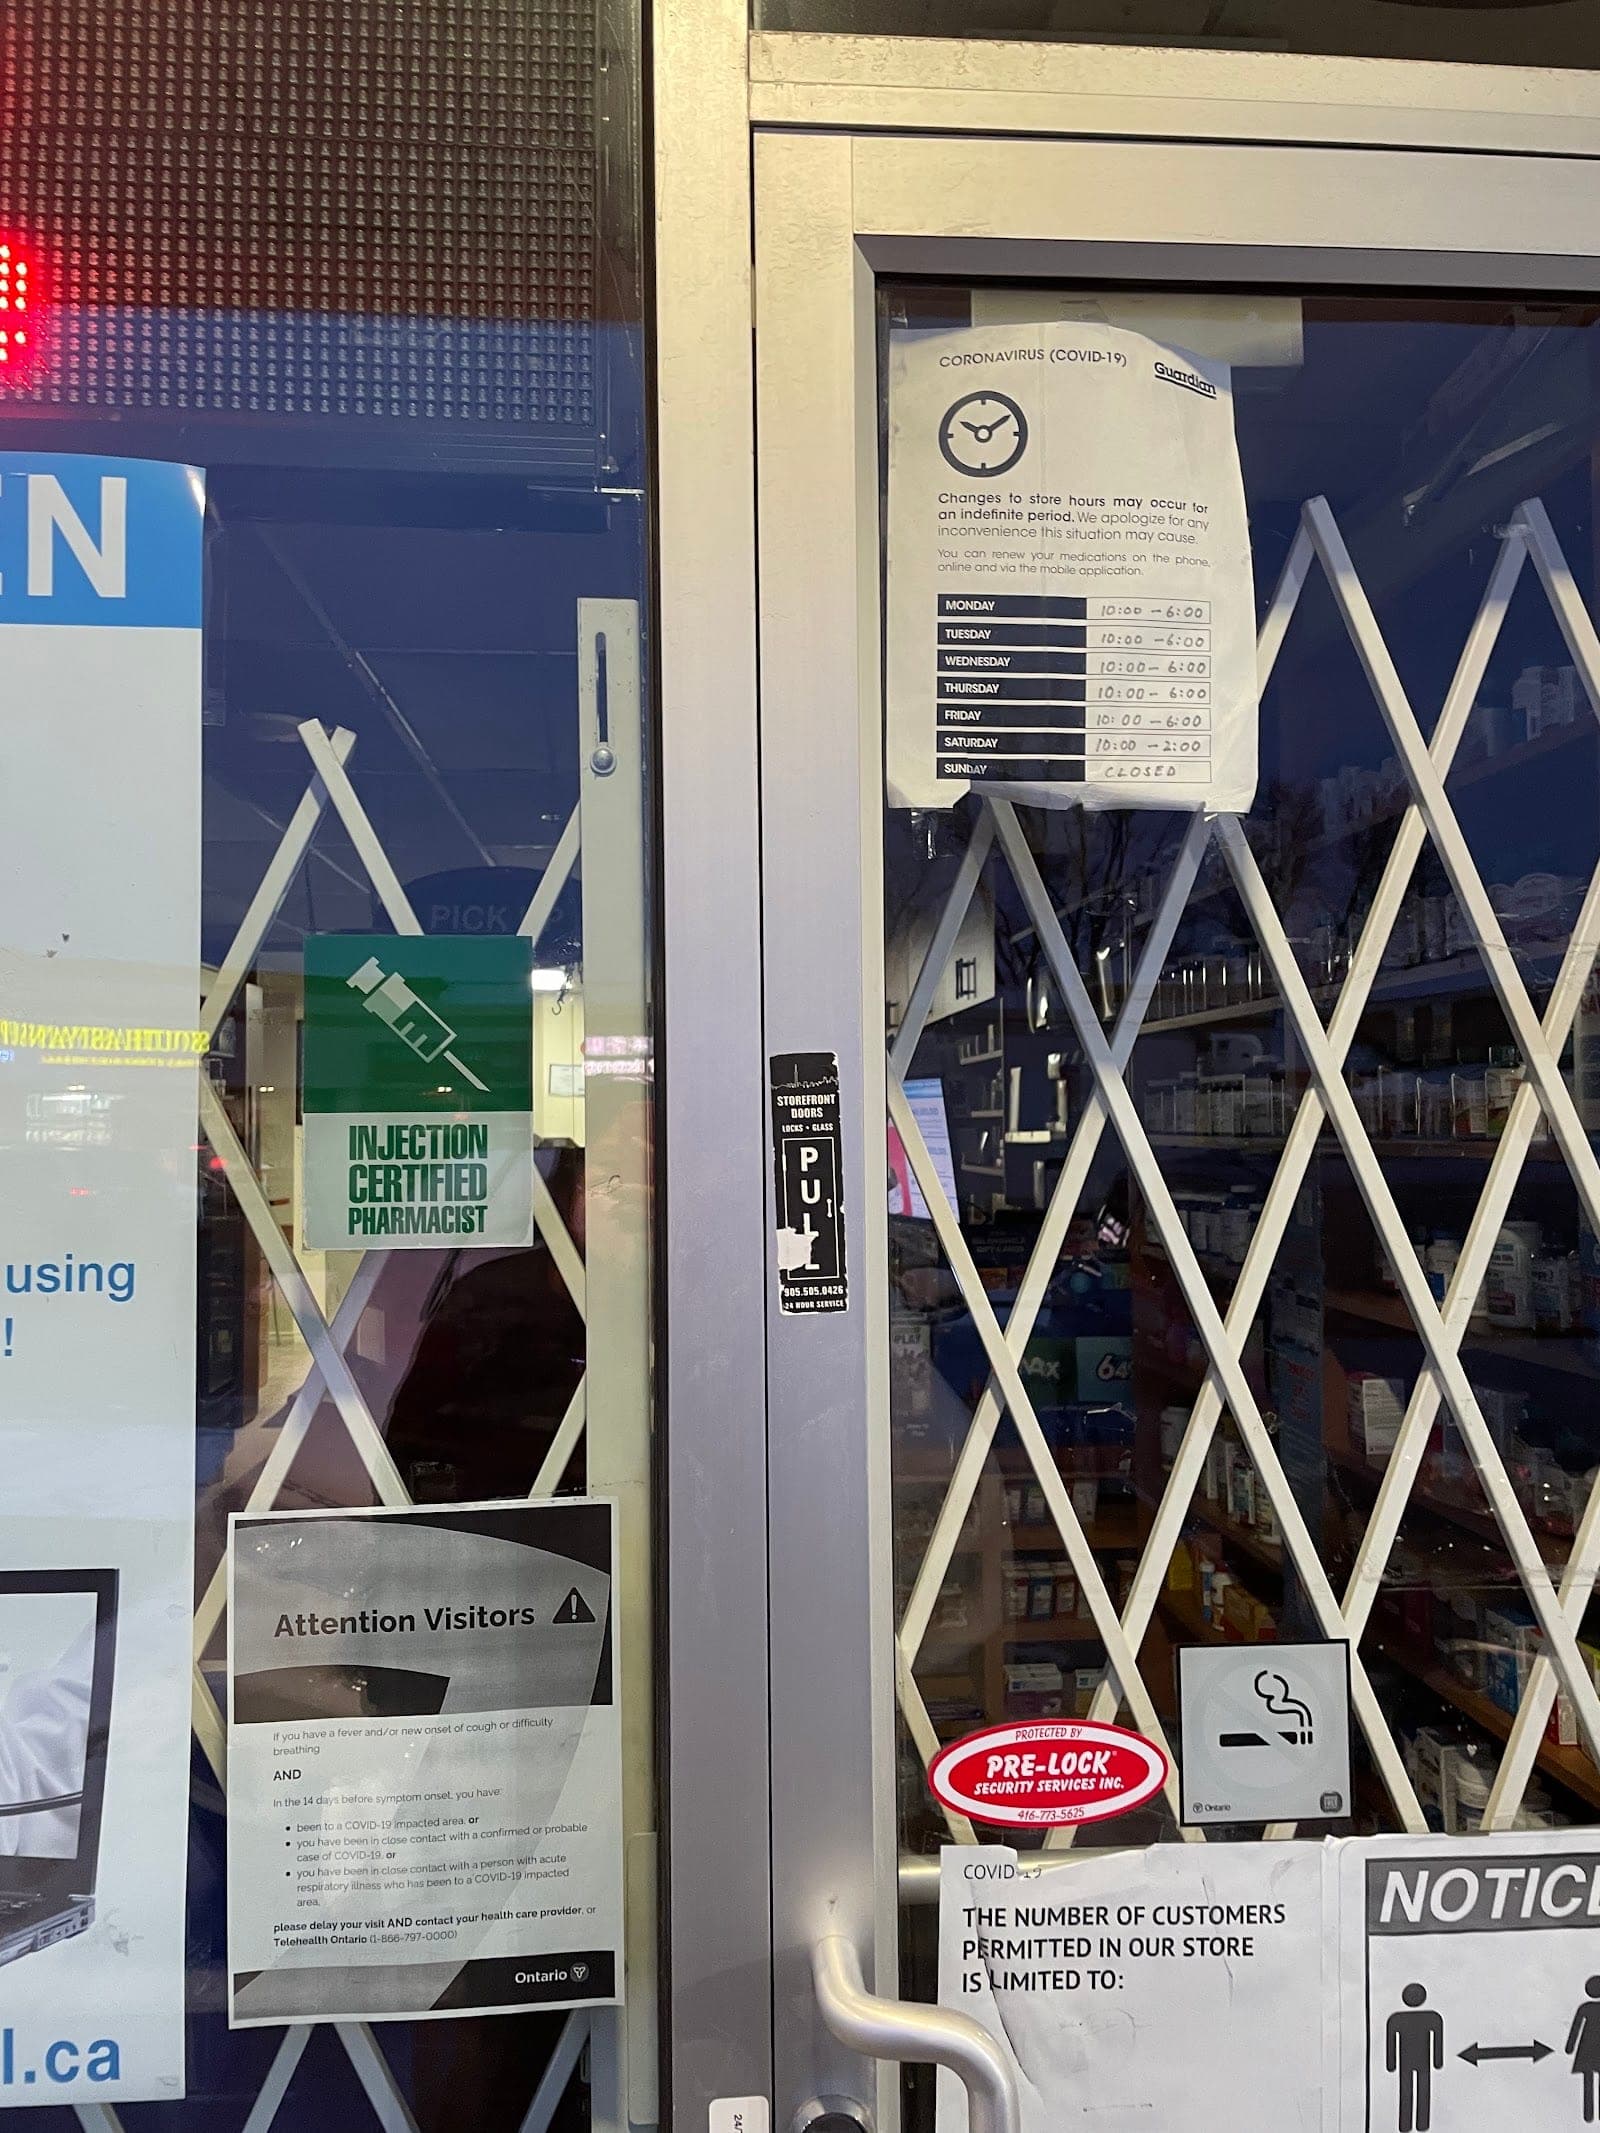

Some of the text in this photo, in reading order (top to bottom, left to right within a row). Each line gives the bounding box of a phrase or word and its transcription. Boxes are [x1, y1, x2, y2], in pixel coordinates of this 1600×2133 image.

[939, 349, 1127, 368] CORONAVIRUS (COVID-19)
[1154, 361, 1217, 395] Guardian
[938, 492, 1208, 513] Changes to store hours may occur for
[939, 508, 1209, 532] an indefinite period. We apologize for any
[0, 474, 127, 598] N
[938, 525, 1198, 544] inconvenience this situation may cause.
[938, 549, 958, 558] You
[964, 550, 986, 558] can
[992, 551, 1025, 559] renew
[1031, 551, 1054, 561] your
[1060, 553, 1126, 561] medications
[1153, 553, 1170, 563] the
[938, 562, 971, 572] online
[975, 563, 997, 572] and
[1000, 563, 1016, 572] via
[1019, 563, 1036, 573] the
[1040, 564, 1076, 574] mobile
[945, 600, 995, 611] MONDAY
[945, 629, 991, 639] TUESDAY
[945, 656, 1011, 667] WEDNESDAY
[945, 683, 999, 694] THURSDAY
[944, 710, 981, 721] FRIDAY
[944, 737, 998, 748] SATURDAY
[944, 764, 987, 774] SUNDAY
[431, 905, 508, 931] PICK
[777, 1094, 835, 1106] STOREFRONT
[791, 1107, 823, 1118] DOORS
[782, 1123, 833, 1132] LOCKS GLASS
[349, 1125, 488, 1161] INJECTION
[349, 1164, 487, 1203] CERTIFIED
[348, 1205, 488, 1235] PHARMACIST
[6, 1253, 135, 1302] using
[816, 1300, 844, 1308] SERVICE
[274, 1605, 535, 1637] Attention Visitors
[282, 1734, 300, 1742] you
[303, 1731, 326, 1739] have
[338, 1729, 362, 1737] fever
[365, 1728, 399, 1736] and/or
[425, 1725, 451, 1734] onset
[466, 1721, 496, 1732] cough
[512, 1718, 553, 1729] difficulty
[1016, 1728, 1082, 1741] PROTECTED BY
[273, 1745, 320, 1755] breathing
[987, 1750, 1111, 1778] PRE-LOCK
[273, 1770, 301, 1780] AND
[974, 1777, 1124, 1795] SECURITY SERVICES INC.
[285, 1798, 300, 1807] the
[304, 1797, 313, 1805] 14
[316, 1795, 338, 1805] days
[341, 1795, 373, 1804] before
[376, 1794, 421, 1805] symptom
[456, 1790, 474, 1800] you
[1018, 1807, 1084, 1820] 416-773-5625
[1205, 1804, 1231, 1812] Ontario
[345, 1821, 391, 1829] COVID-19
[394, 1818, 439, 1829] impacted
[410, 1824, 587, 1843] contact with confirmed probable
[386, 1851, 395, 1859] or
[450, 1855, 566, 1871] with person with acute
[297, 1869, 569, 1896] respiratory COVID-19 impacted
[274, 1923, 307, 1934] please
[310, 1920, 338, 1931] delay
[340, 1921, 362, 1931] your
[365, 1920, 385, 1928] visit
[387, 1918, 412, 1928] AND
[415, 1915, 453, 1926] contact
[456, 1913, 478, 1925] your
[481, 1910, 513, 1920] health
[963, 1904, 1285, 1927] THE NUMBER OF CUSTOMERS
[274, 1935, 328, 1946] Telehealth
[330, 1935, 367, 1944] Ontario
[963, 1937, 1253, 1960] PERMITTED IN OUR STORE
[515, 1969, 567, 1983] Ontario
[963, 1970, 1123, 1992] IS LIMITED TO:
[3, 2028, 120, 2084] l.ca
[734, 2114, 743, 2133] 24/
